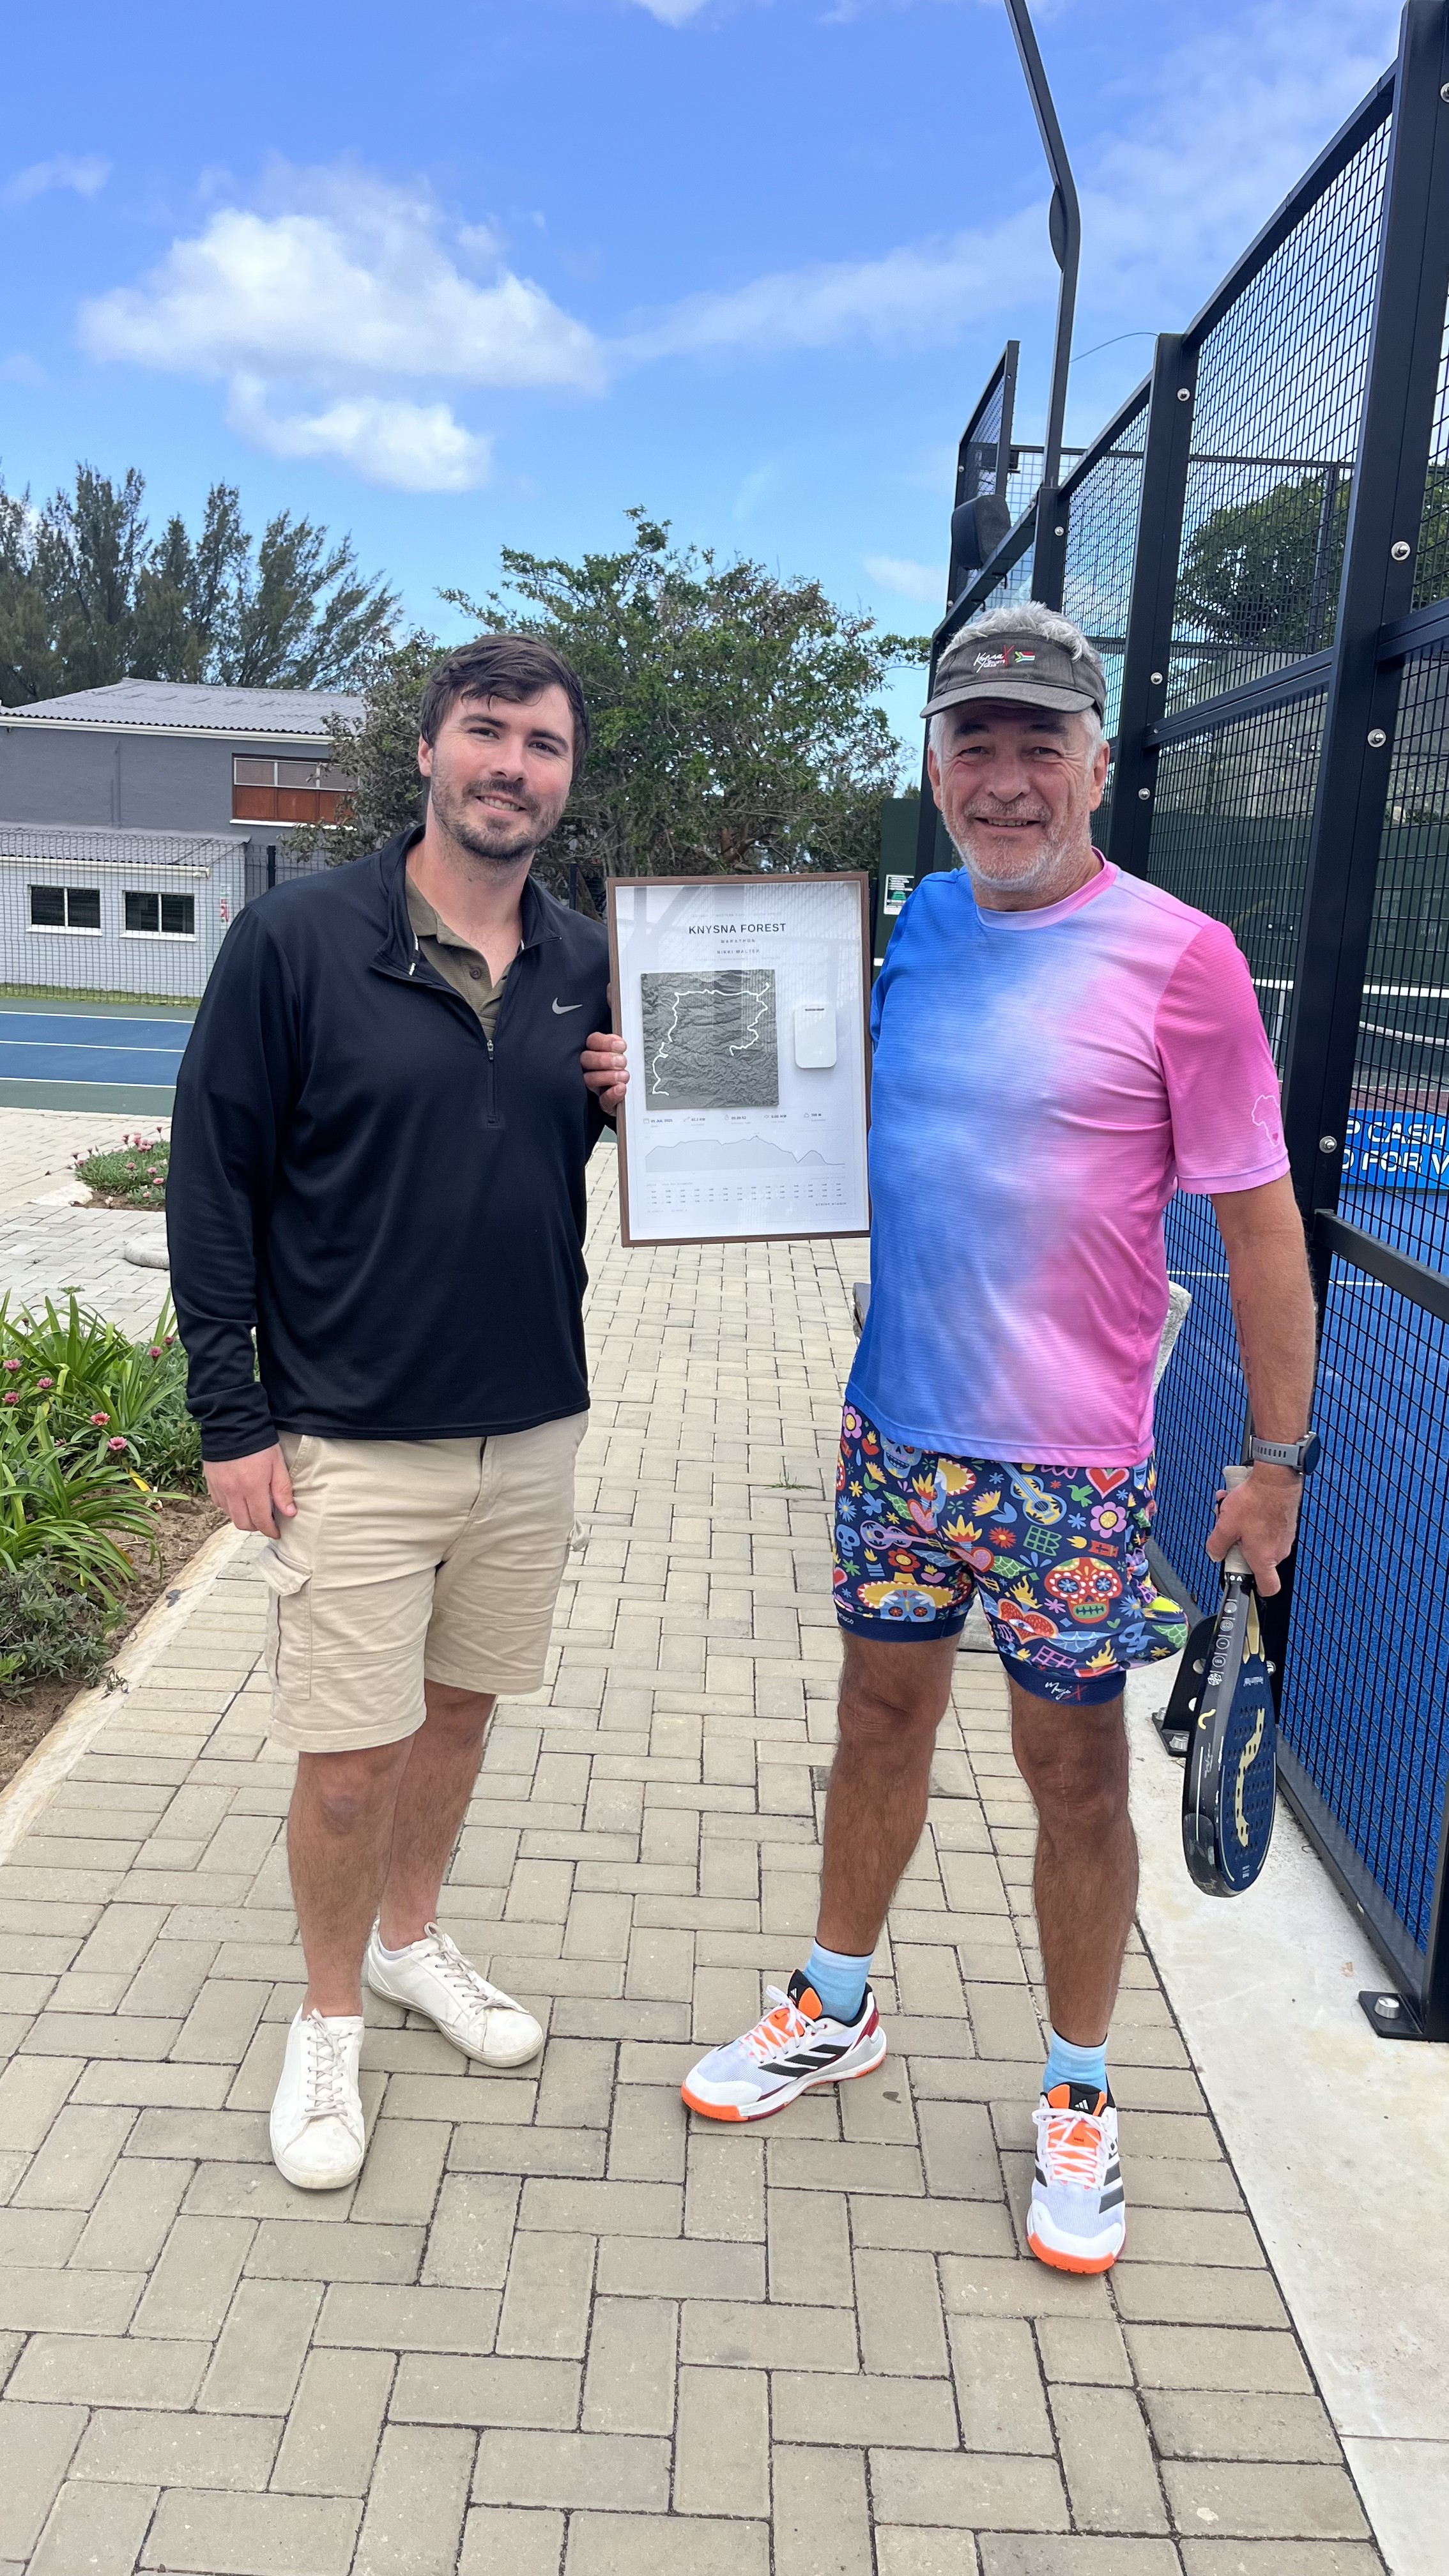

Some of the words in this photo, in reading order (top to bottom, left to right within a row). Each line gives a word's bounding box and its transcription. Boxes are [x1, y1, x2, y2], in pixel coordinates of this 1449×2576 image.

[689, 924, 737, 935] KNYSNA
[740, 923, 786, 933] FOREST
[1367, 1121, 1446, 1146] CASH
[1361, 1150, 1423, 1174] FOR
